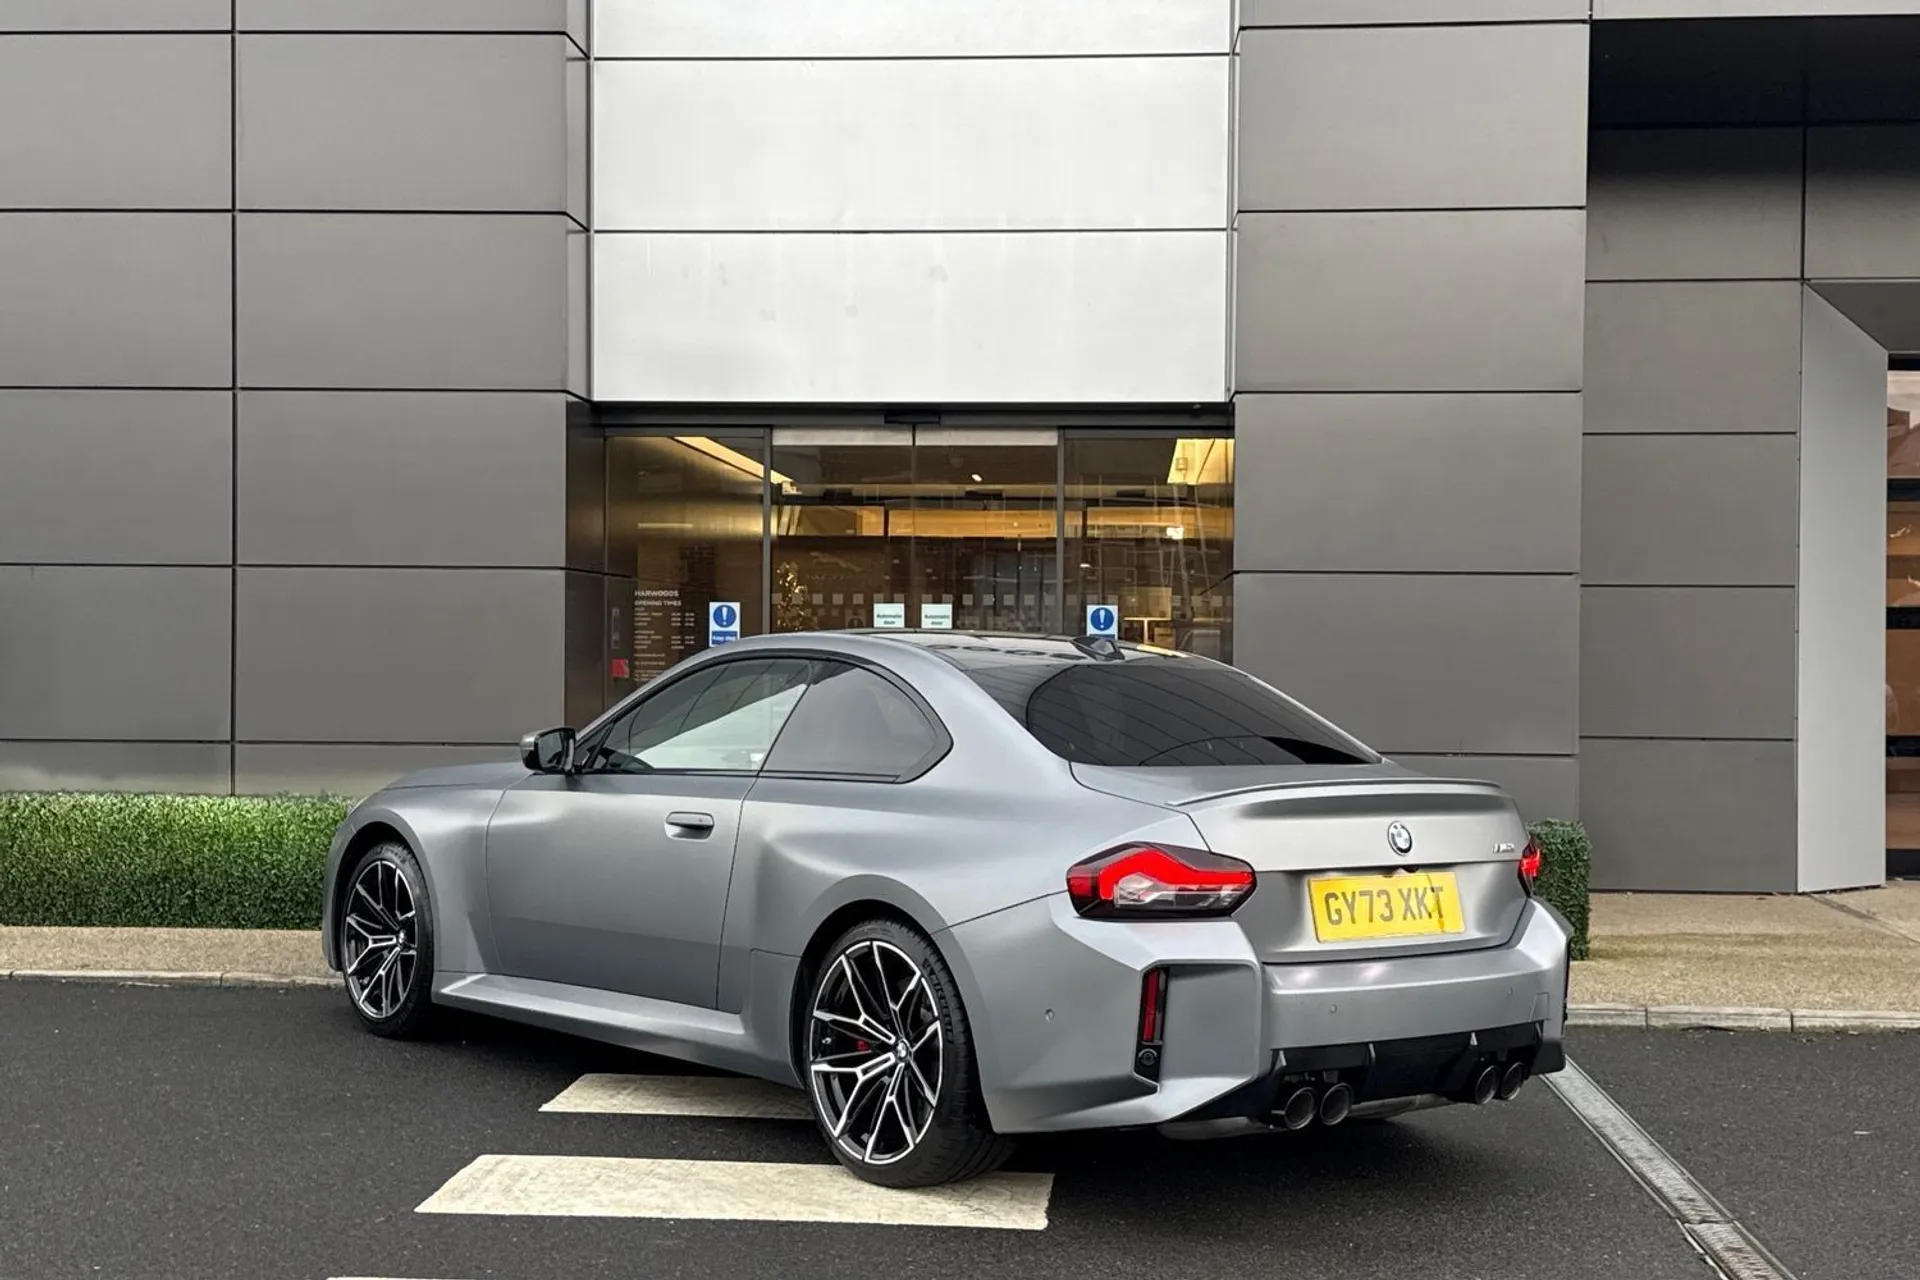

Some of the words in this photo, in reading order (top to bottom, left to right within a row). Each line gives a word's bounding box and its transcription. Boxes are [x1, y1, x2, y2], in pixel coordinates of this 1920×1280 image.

[634, 589, 679, 597] HARWOODS
[1324, 889, 1394, 926] GY73
[1398, 886, 1444, 921] XKT
